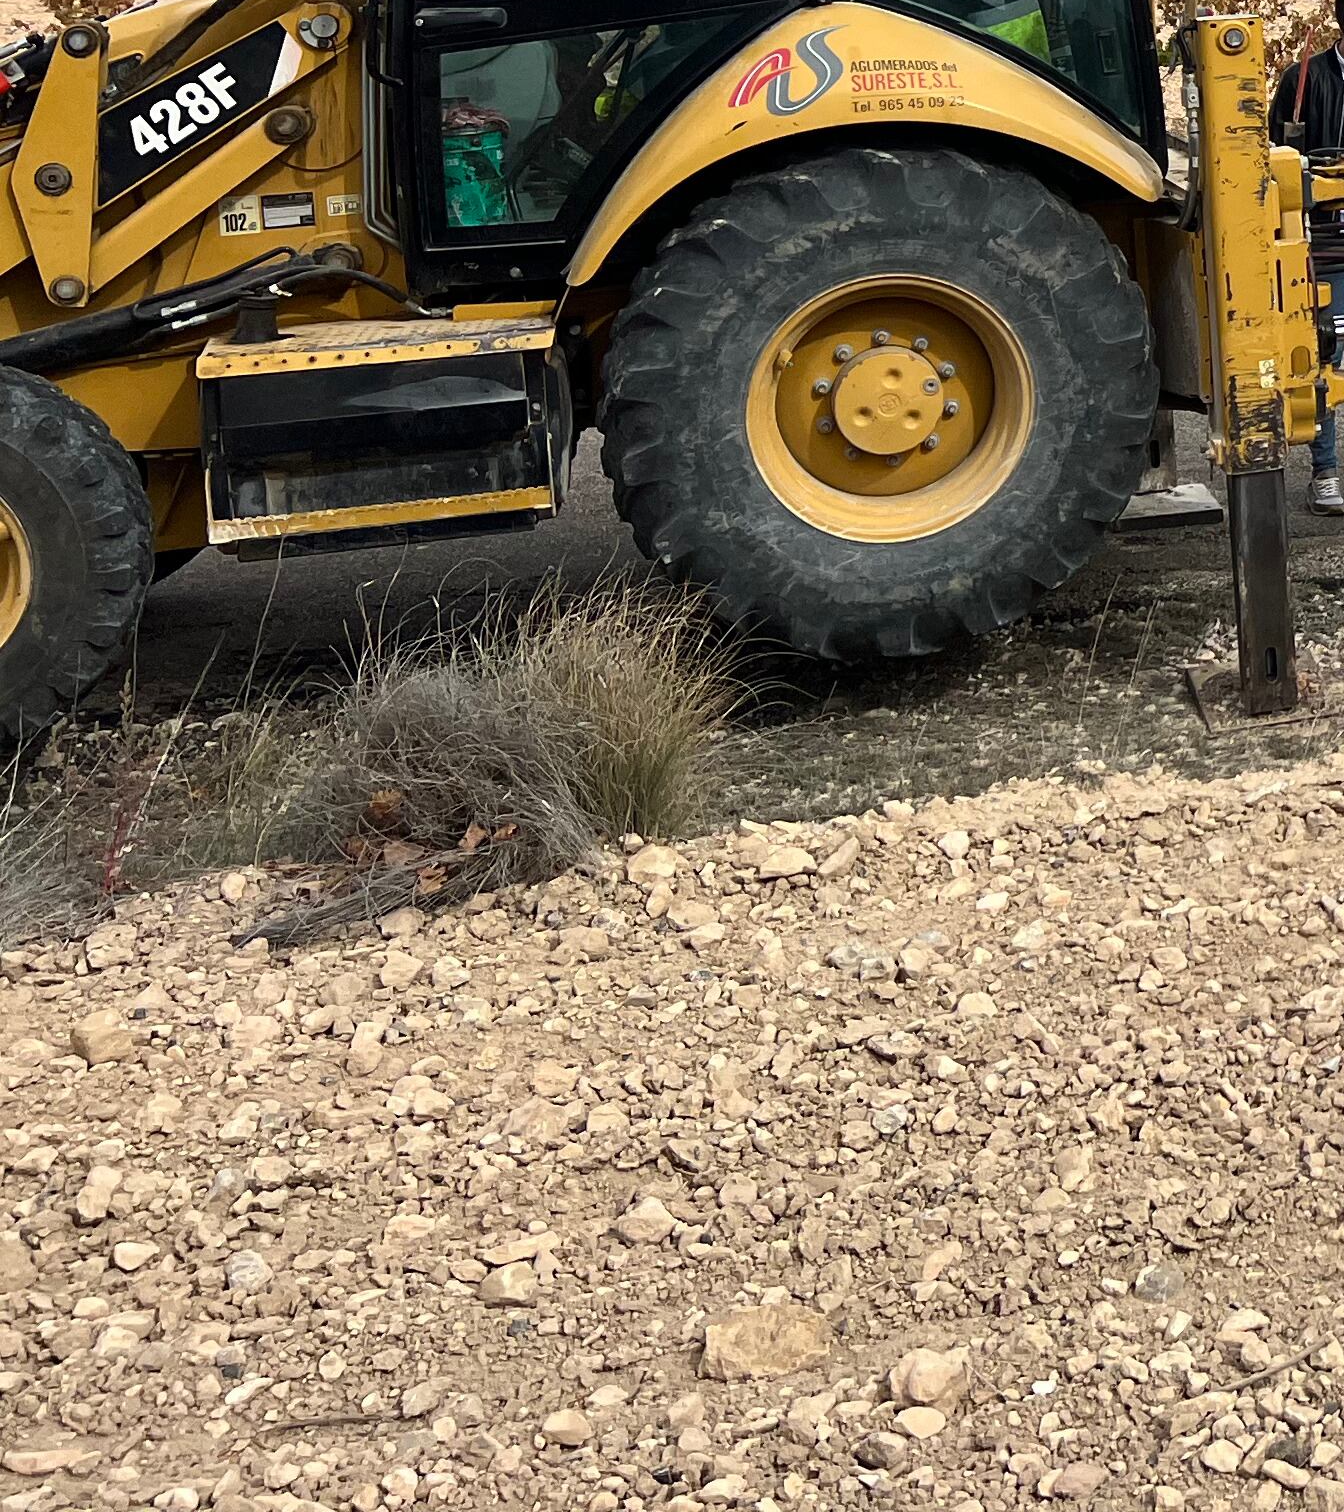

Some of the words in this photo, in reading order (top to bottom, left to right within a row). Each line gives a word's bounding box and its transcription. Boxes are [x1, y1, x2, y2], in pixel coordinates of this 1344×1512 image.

[850, 59, 939, 73] AGLOMERADOS
[941, 62, 958, 73] del
[130, 62, 237, 156] 428F
[879, 99, 904, 111] 965
[907, 98, 924, 110] 45
[928, 96, 945, 108] 09
[222, 213, 247, 233] 102
